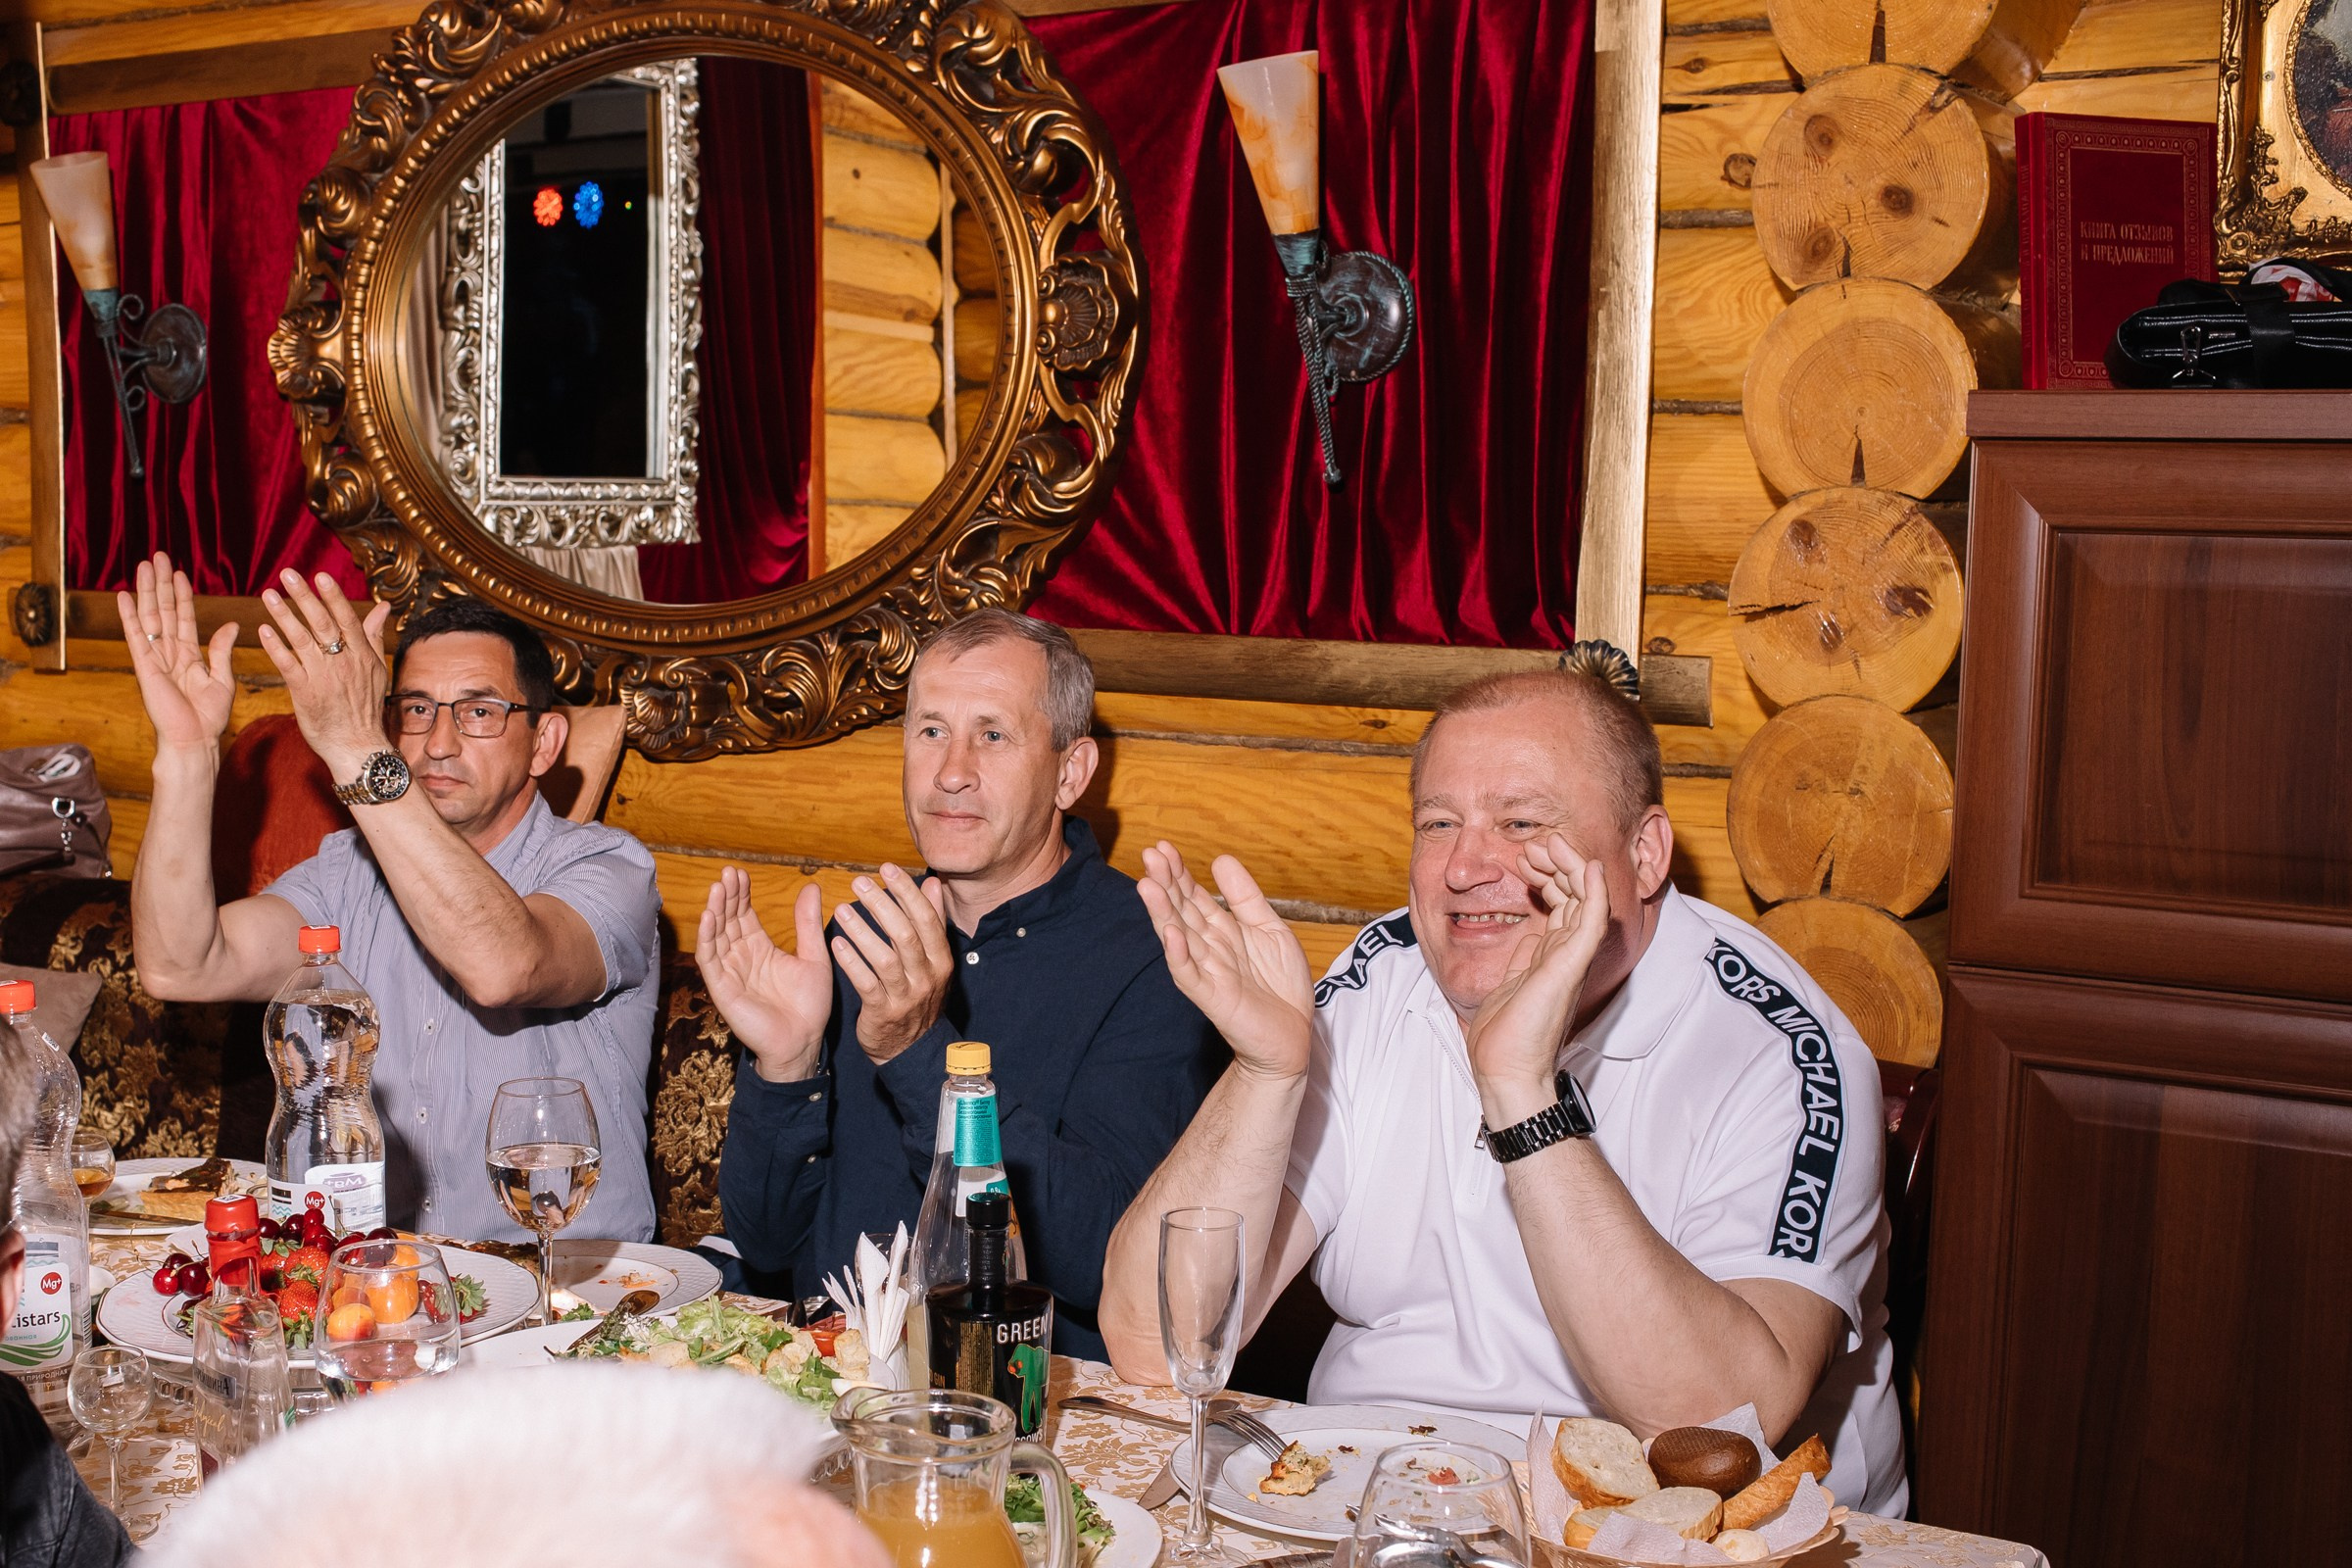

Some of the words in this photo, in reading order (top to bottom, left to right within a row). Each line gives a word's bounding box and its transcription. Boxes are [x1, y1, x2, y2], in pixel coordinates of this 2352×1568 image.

[2081, 221, 2116, 239] КНИГА
[2121, 223, 2174, 242] ОТЗЫВОВ
[2082, 244, 2087, 262] И
[2093, 244, 2174, 266] ПРЕДЛОЖЕНИЙ
[1768, 1004, 1840, 1156] MICHAEL
[306, 1196, 325, 1207] Mg+
[42, 1278, 62, 1290] Mg+
[12, 1311, 61, 1328] istars
[997, 1312, 1049, 1344] GREEN
[26, 1368, 68, 1382] ПРИРОДНАЯ
